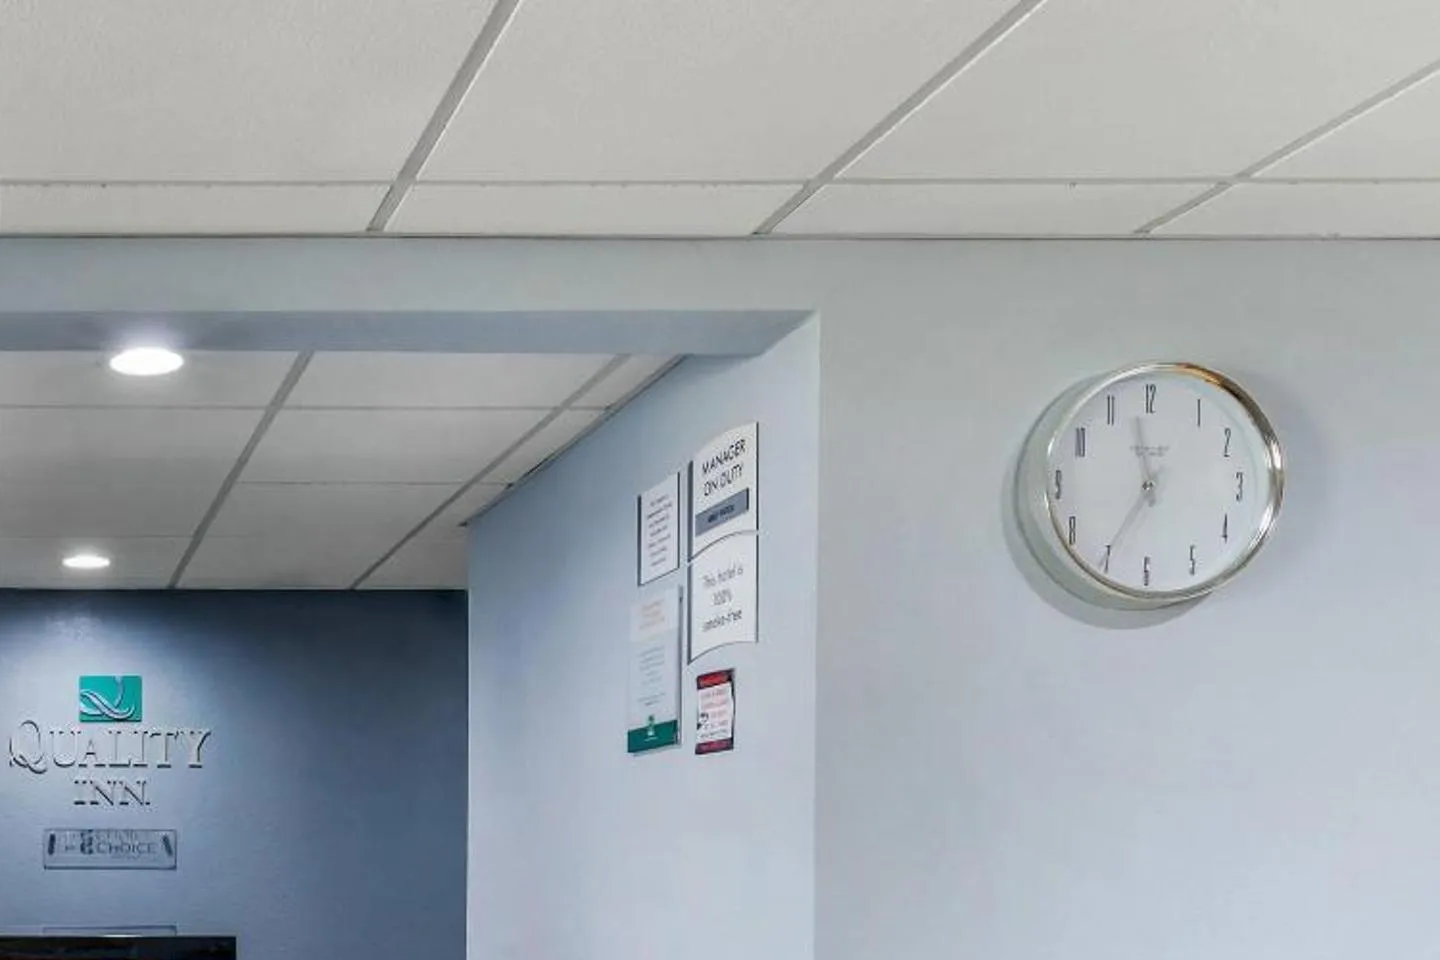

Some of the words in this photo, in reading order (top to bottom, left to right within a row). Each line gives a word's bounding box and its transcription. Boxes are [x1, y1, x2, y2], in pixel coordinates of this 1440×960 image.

[1106, 395, 1115, 425] 11
[1145, 384, 1157, 414] 12
[702, 439, 746, 475] MANAGER
[1075, 427, 1086, 458] 10
[1223, 427, 1232, 458] 2
[703, 480, 719, 496] ON
[720, 462, 745, 488] DUTY
[1055, 469, 1063, 500] 9
[1235, 471, 1244, 501] 3
[1068, 515, 1076, 545] 8
[1220, 513, 1229, 544] 4
[1103, 544, 1112, 574] 7
[1143, 555, 1151, 587] 6
[1188, 544, 1197, 576] 5
[9, 719, 212, 775] QUALITY
[73, 779, 150, 807] INN
[96, 841, 157, 855] CHOICE
